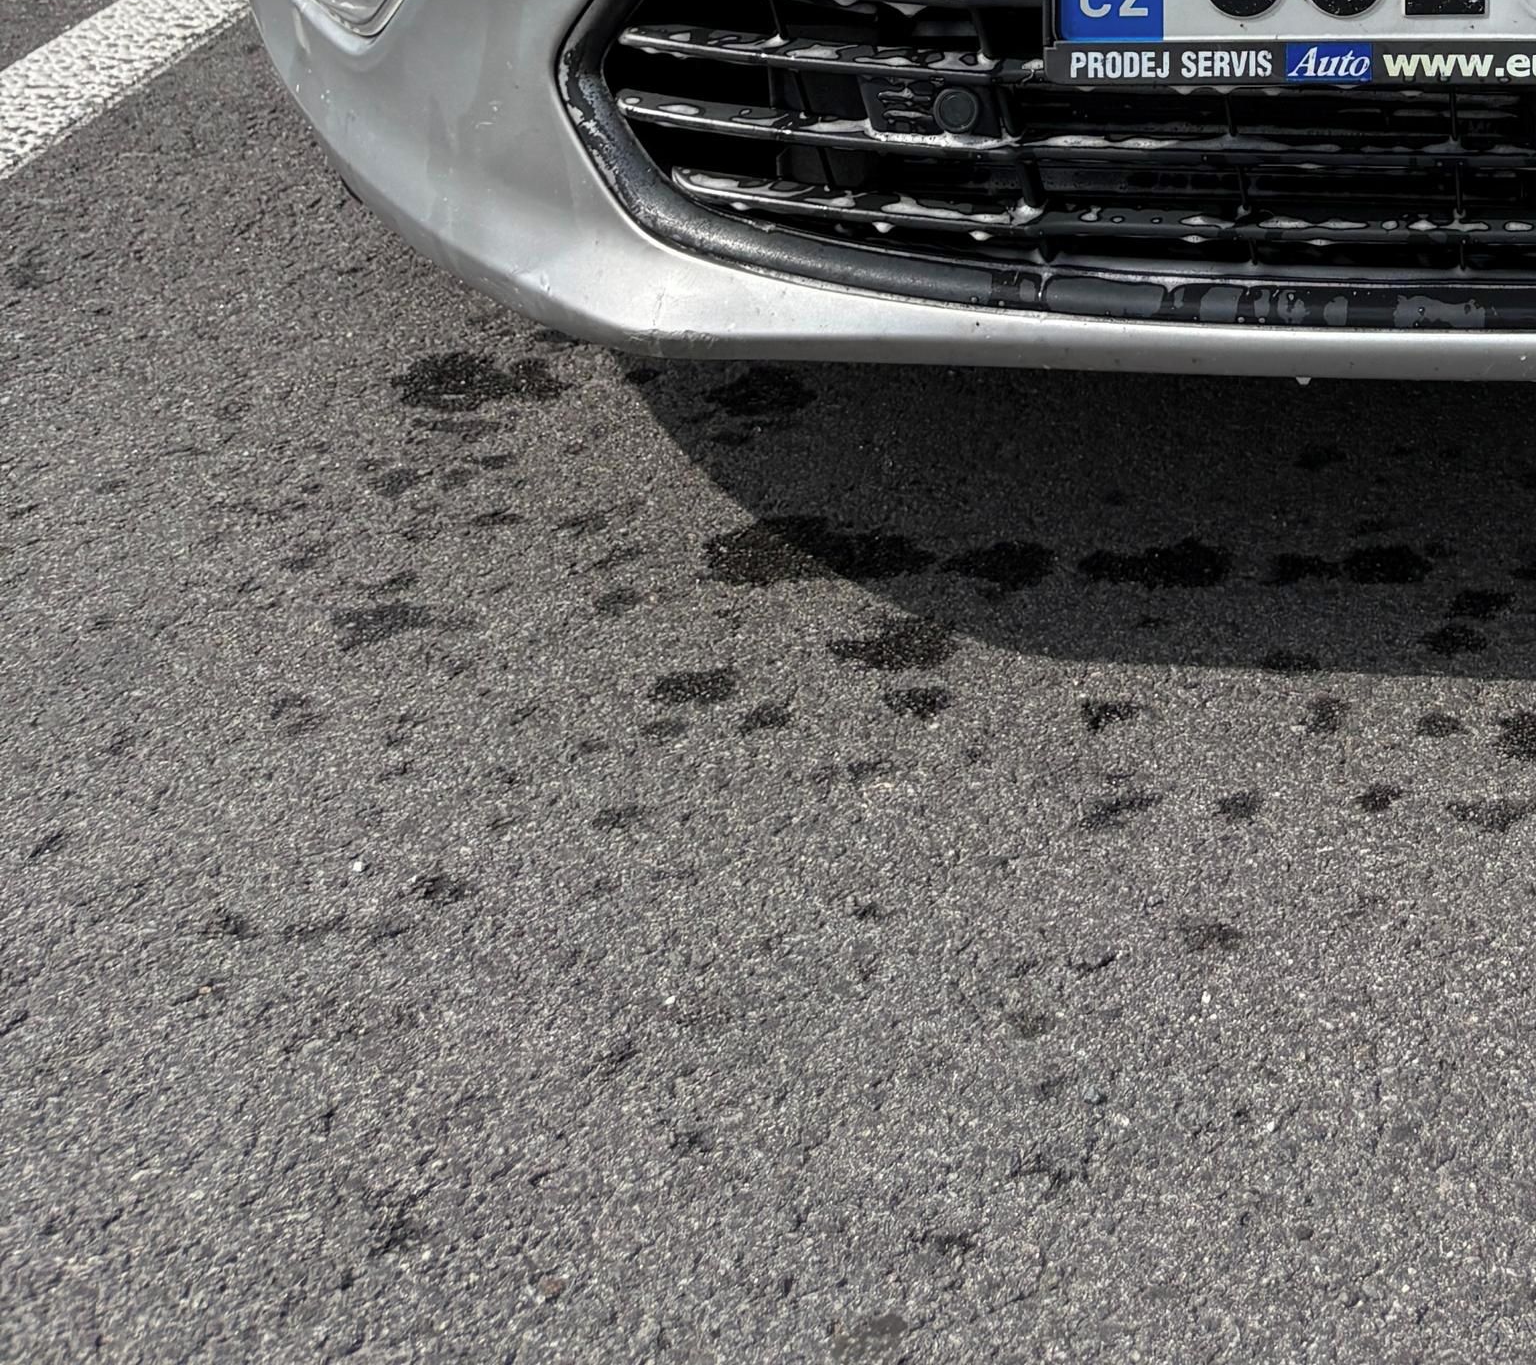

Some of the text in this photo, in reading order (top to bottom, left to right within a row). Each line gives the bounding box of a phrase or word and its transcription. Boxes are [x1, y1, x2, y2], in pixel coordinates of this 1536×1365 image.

[1069, 51, 1170, 78] PRODEJ
[1180, 50, 1273, 78] SERVIS
[1287, 46, 1371, 82] Auto
